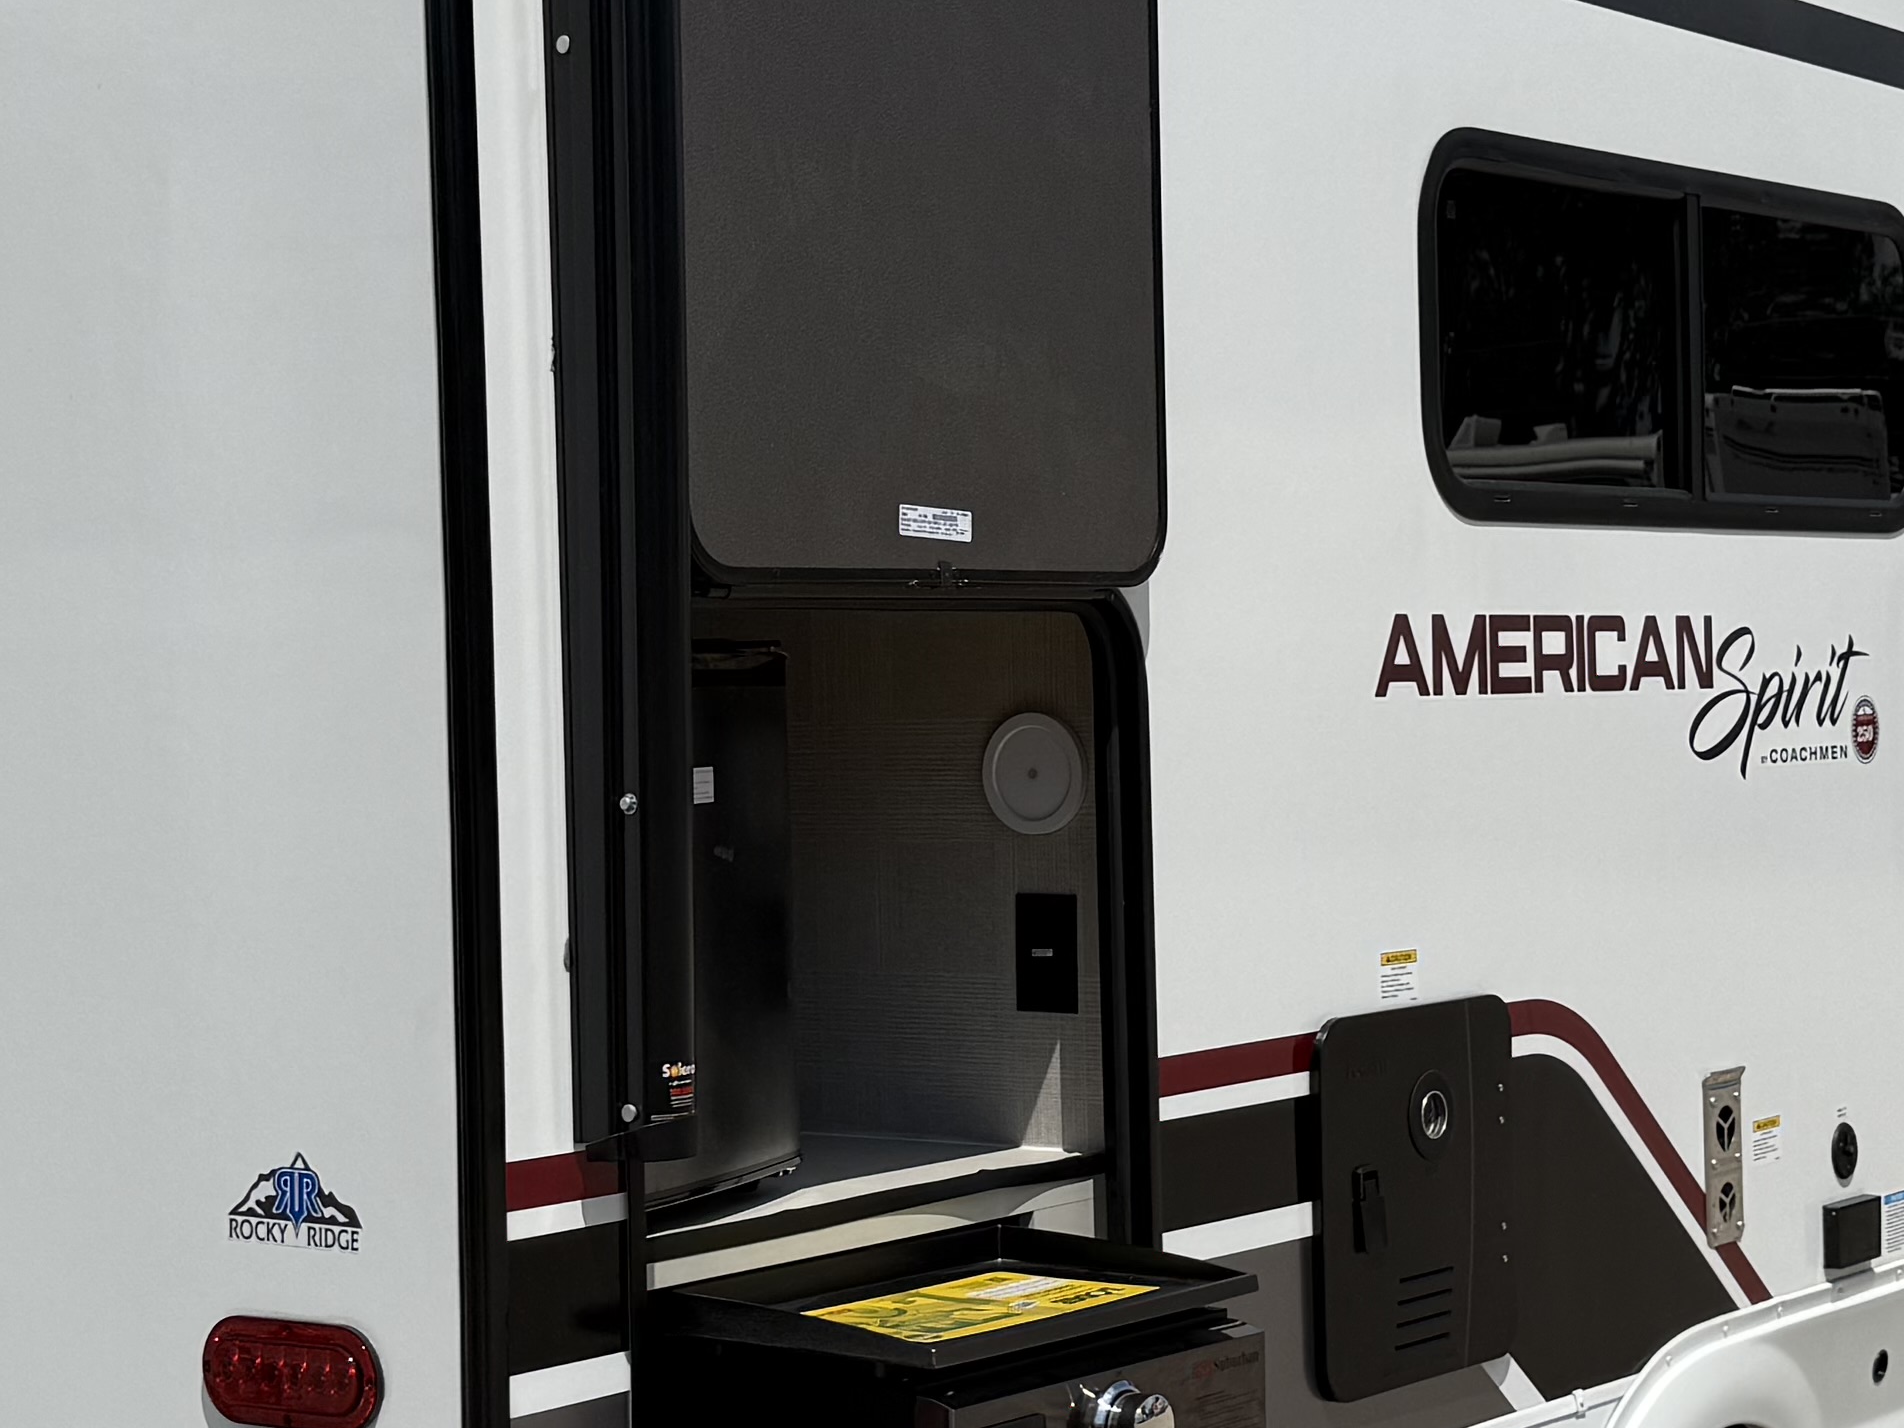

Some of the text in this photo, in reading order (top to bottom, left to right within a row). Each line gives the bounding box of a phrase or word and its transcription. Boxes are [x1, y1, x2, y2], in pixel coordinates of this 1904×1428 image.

[1373, 613, 1870, 780] AMERICAN Spirit
[1856, 724, 1874, 742] 250
[1769, 744, 1848, 764] COACHMEN
[228, 1218, 360, 1252] ROCKY RIDGE
